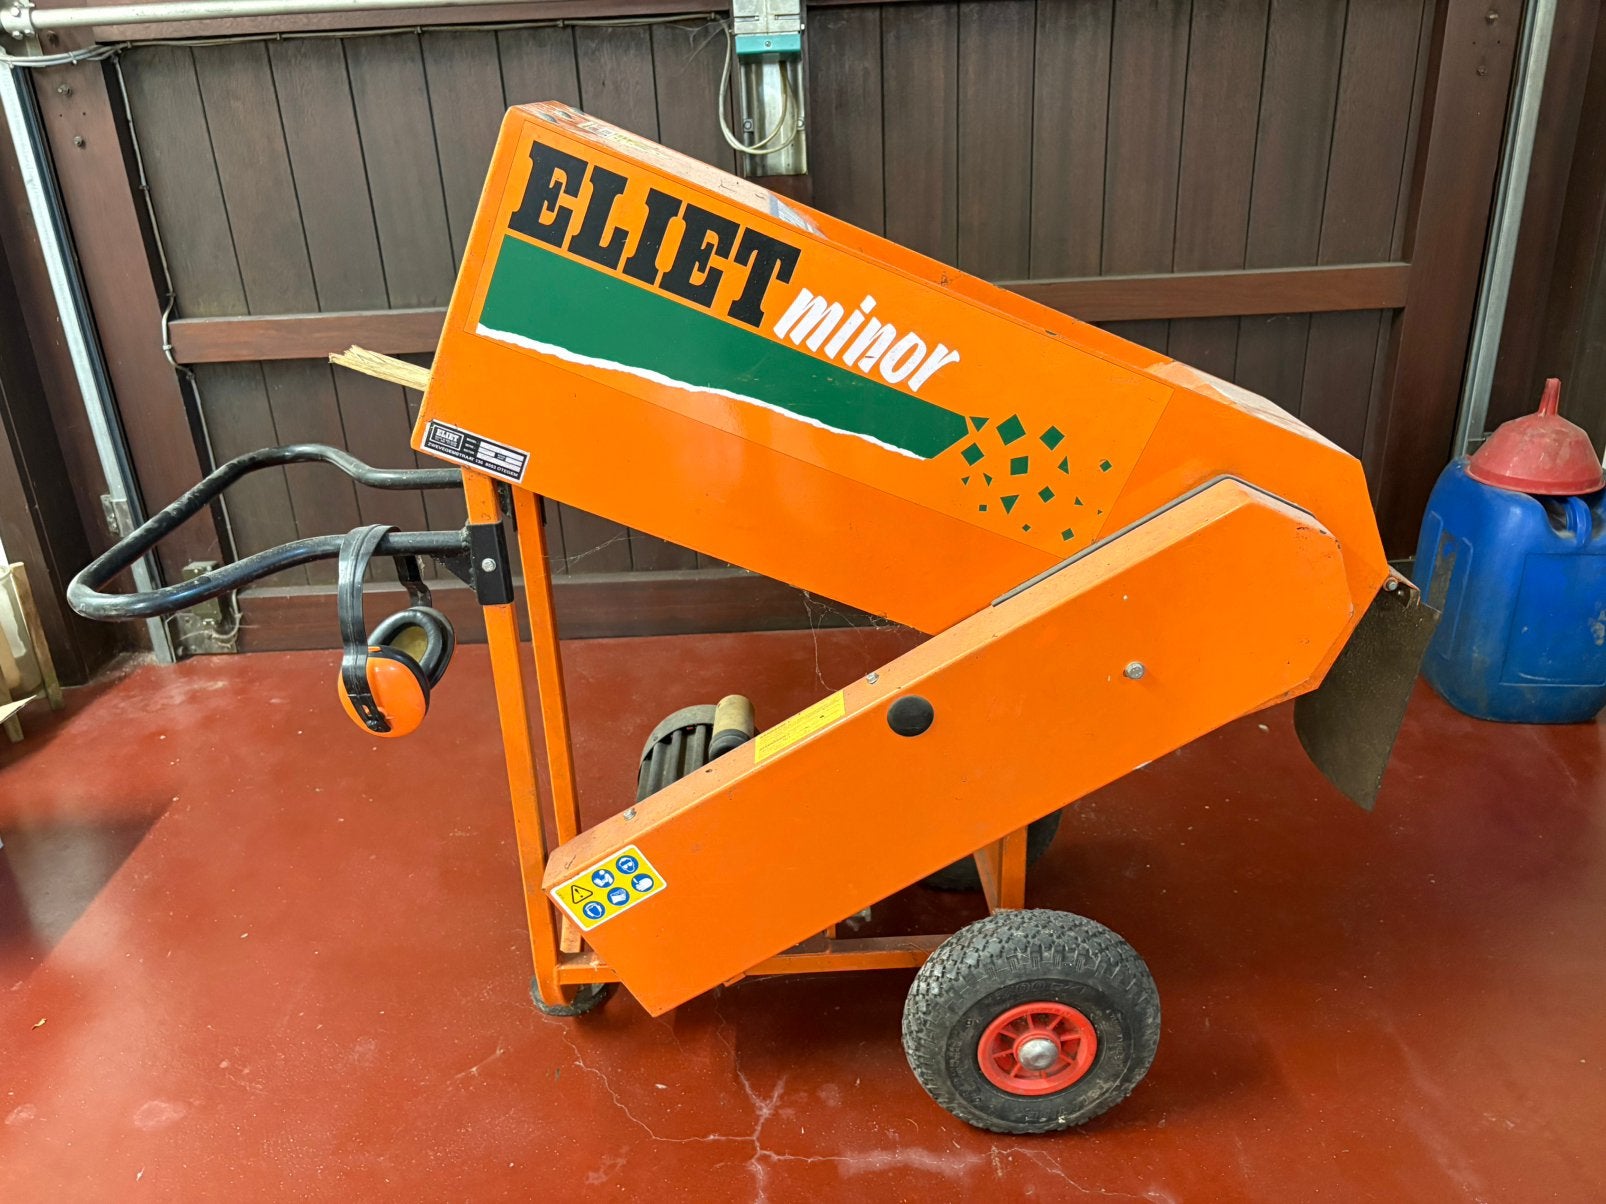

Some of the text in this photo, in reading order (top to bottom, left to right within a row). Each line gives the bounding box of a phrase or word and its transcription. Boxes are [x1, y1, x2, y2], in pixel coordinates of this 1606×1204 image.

[508, 140, 960, 392] ELIET minor
[436, 428, 459, 442] ELIET
